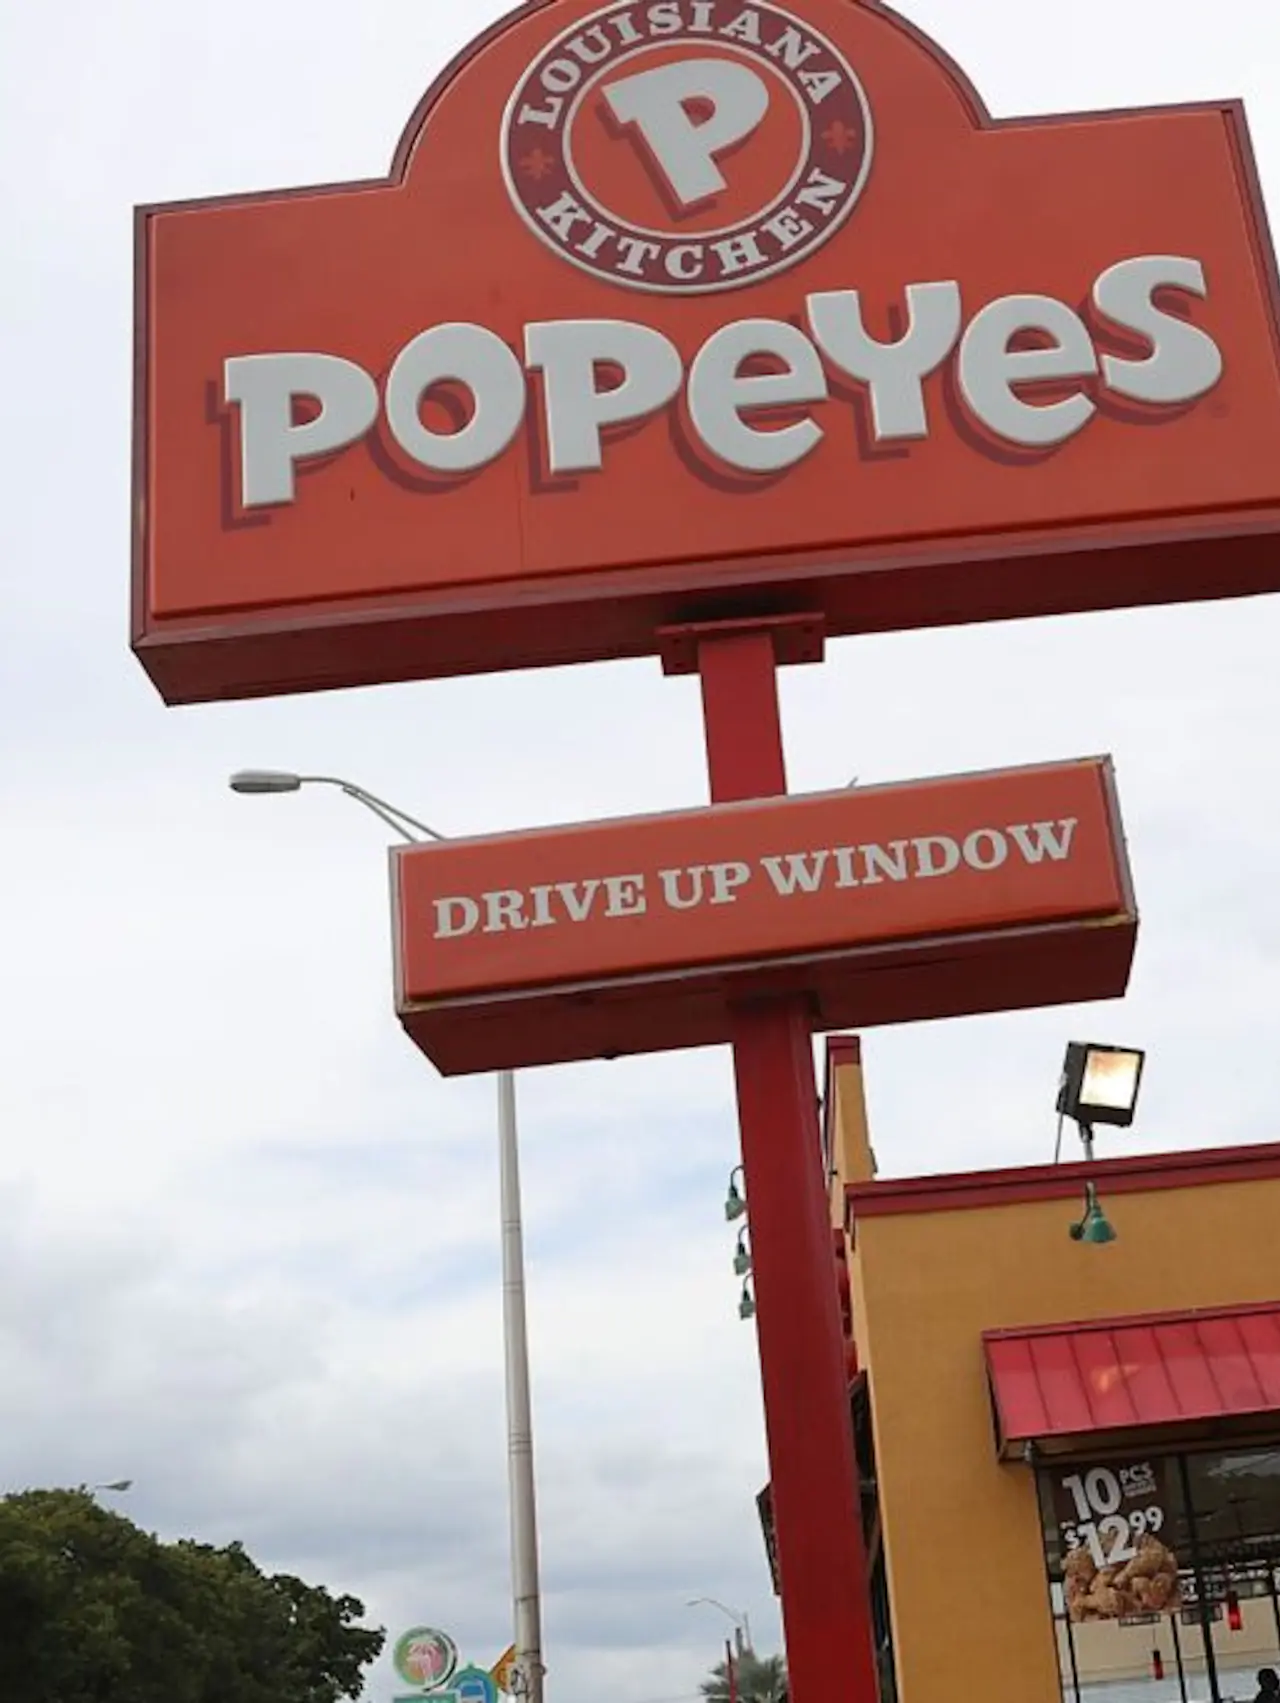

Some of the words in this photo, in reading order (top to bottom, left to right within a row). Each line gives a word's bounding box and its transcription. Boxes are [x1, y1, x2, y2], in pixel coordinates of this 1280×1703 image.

[518, 0, 843, 130] LOUISIANA
[600, 57, 769, 206] P
[536, 167, 847, 280] KITCHEN
[224, 254, 1223, 510] POPEYES
[433, 872, 646, 939] DRIVE
[659, 859, 751, 911] UP
[760, 817, 1078, 896] WINDOW
[1062, 1467, 1121, 1520] 10
